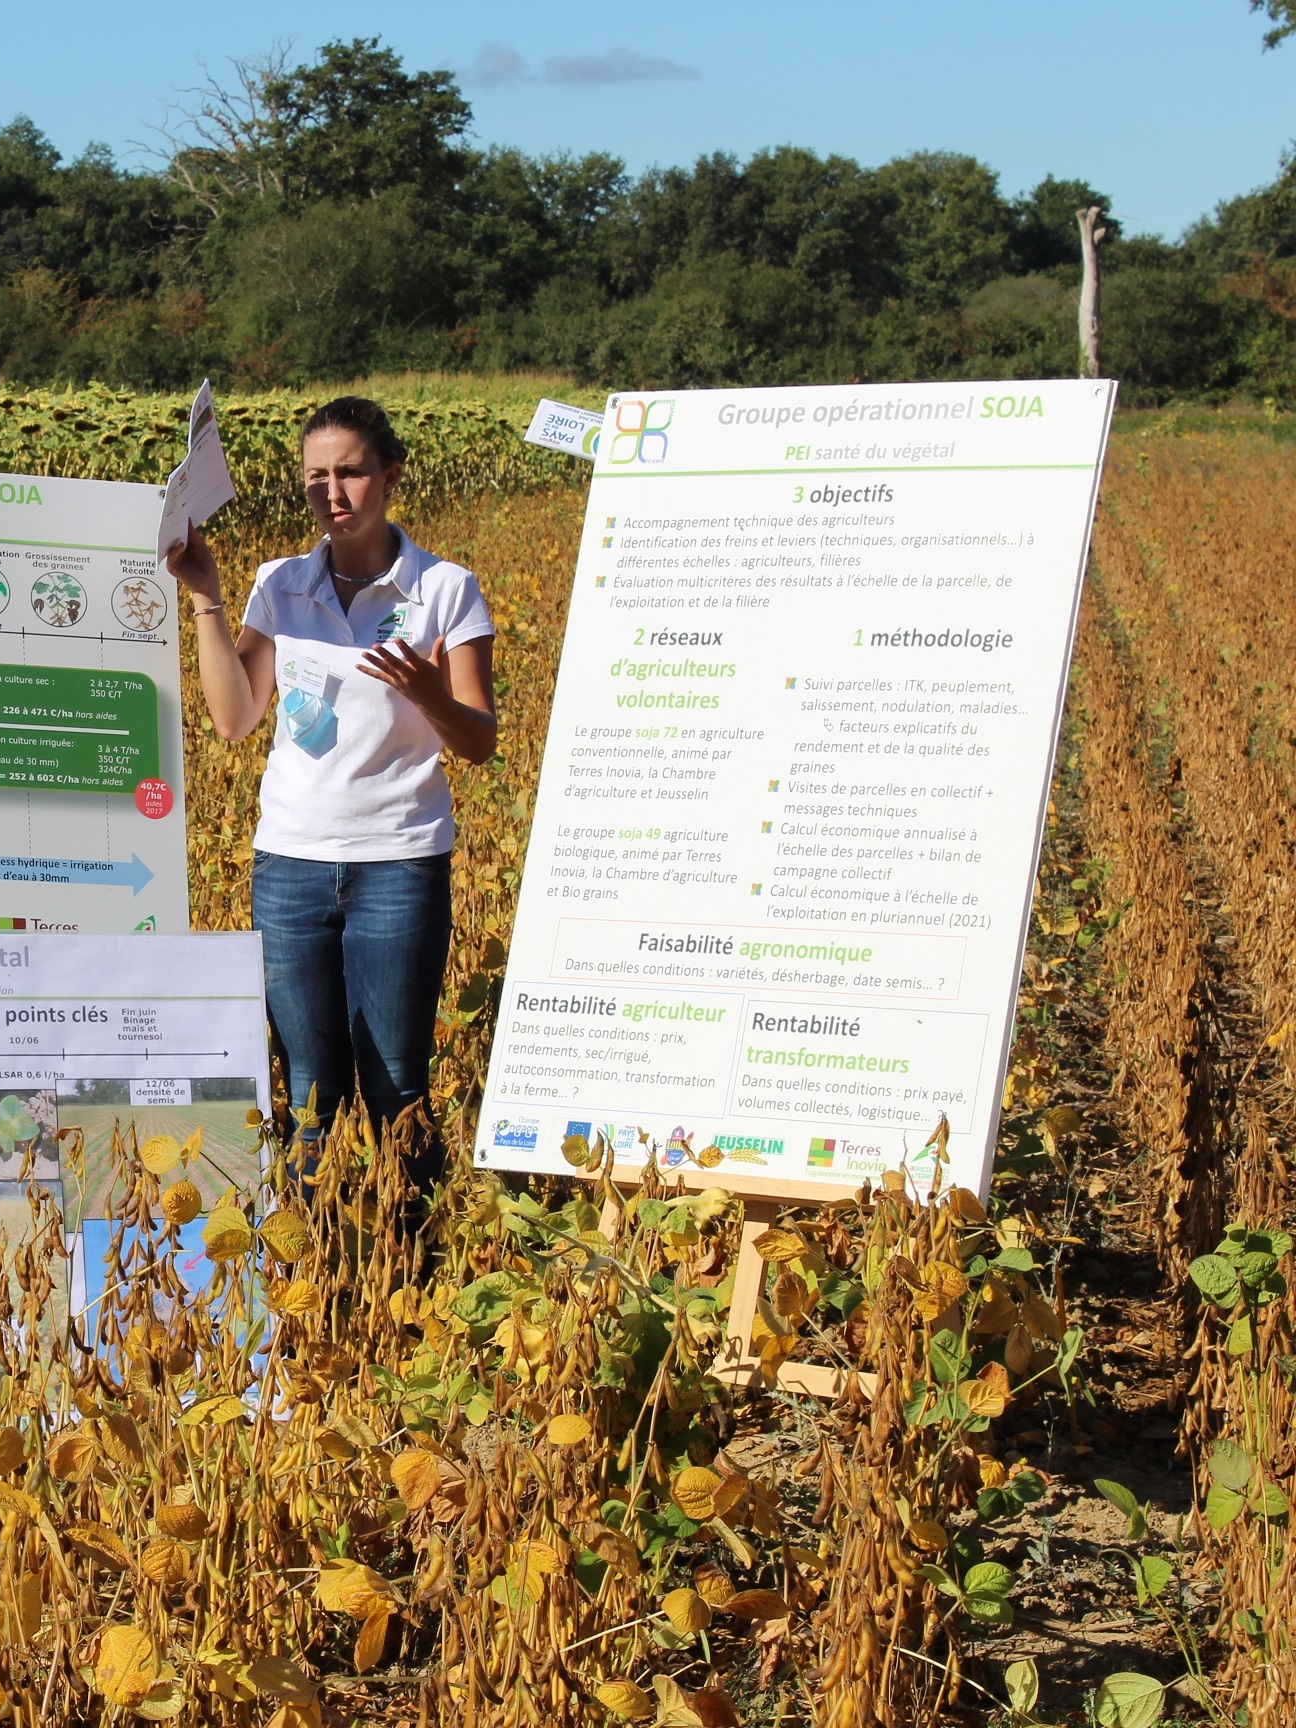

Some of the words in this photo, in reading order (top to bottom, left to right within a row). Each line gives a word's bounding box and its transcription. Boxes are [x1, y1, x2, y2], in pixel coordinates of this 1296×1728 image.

[718, 404, 805, 428] Groupe
[813, 396, 974, 426] opérationnel
[980, 396, 1043, 418] SOJA
[547, 414, 584, 431] LOIRE
[543, 428, 574, 443] PAYS
[785, 446, 810, 461] PEI
[815, 442, 860, 460] santé
[865, 443, 887, 459] du
[892, 443, 955, 463] végétal
[793, 486, 803, 503] 3
[810, 484, 893, 507] objectifs
[624, 517, 729, 531] Accompagnement
[734, 516, 793, 530] technique
[798, 515, 818, 526] des
[822, 514, 894, 529] agriculteurs
[25, 552, 91, 563] Grossissement
[120, 558, 156, 568] Maturité
[32, 560, 48, 568] des
[52, 562, 84, 572] graines
[122, 567, 155, 575] Récolte
[138, 632, 160, 641] sept.
[634, 629, 644, 645] 2
[650, 628, 723, 645] réseaux
[853, 629, 863, 646] 1
[871, 628, 1013, 652] méthodologie
[610, 659, 736, 680] d'agriculteurs
[616, 690, 719, 708] volontaires
[794, 741, 864, 754] rendement
[867, 743, 881, 754] et
[884, 742, 900, 754] de
[904, 742, 915, 755] la
[918, 743, 963, 757] qualité
[967, 744, 990, 756] des
[568, 765, 603, 777] Terres
[606, 766, 644, 779] Inovia,
[648, 766, 659, 778] la
[662, 766, 716, 779] Chambre
[790, 762, 835, 775] graines
[18, 857, 60, 870] hydrique
[70, 861, 113, 873] irrigation
[31, 872, 37, 881] à
[39, 873, 69, 883] 30mm
[639, 933, 733, 955] Faisabilité
[740, 941, 872, 965] agronomique
[6, 1007, 66, 1026] points
[72, 1005, 108, 1022] clés
[138, 1008, 156, 1016] juin
[517, 993, 616, 1016] Rentabilité
[622, 1002, 726, 1022] agriculteur
[123, 1017, 155, 1025] Binage
[752, 1012, 860, 1036] Rentabilité
[10, 1037, 39, 1045] 10/06
[747, 1046, 909, 1073] transformateurs
[27, 1071, 41, 1079] 0,6
[44, 1071, 65, 1079] l/ha
[136, 1088, 170, 1096] densité
[711, 1135, 784, 1155] JEUSSELIN
[840, 1140, 881, 1156] Terres
[846, 1157, 886, 1171] Inovia
